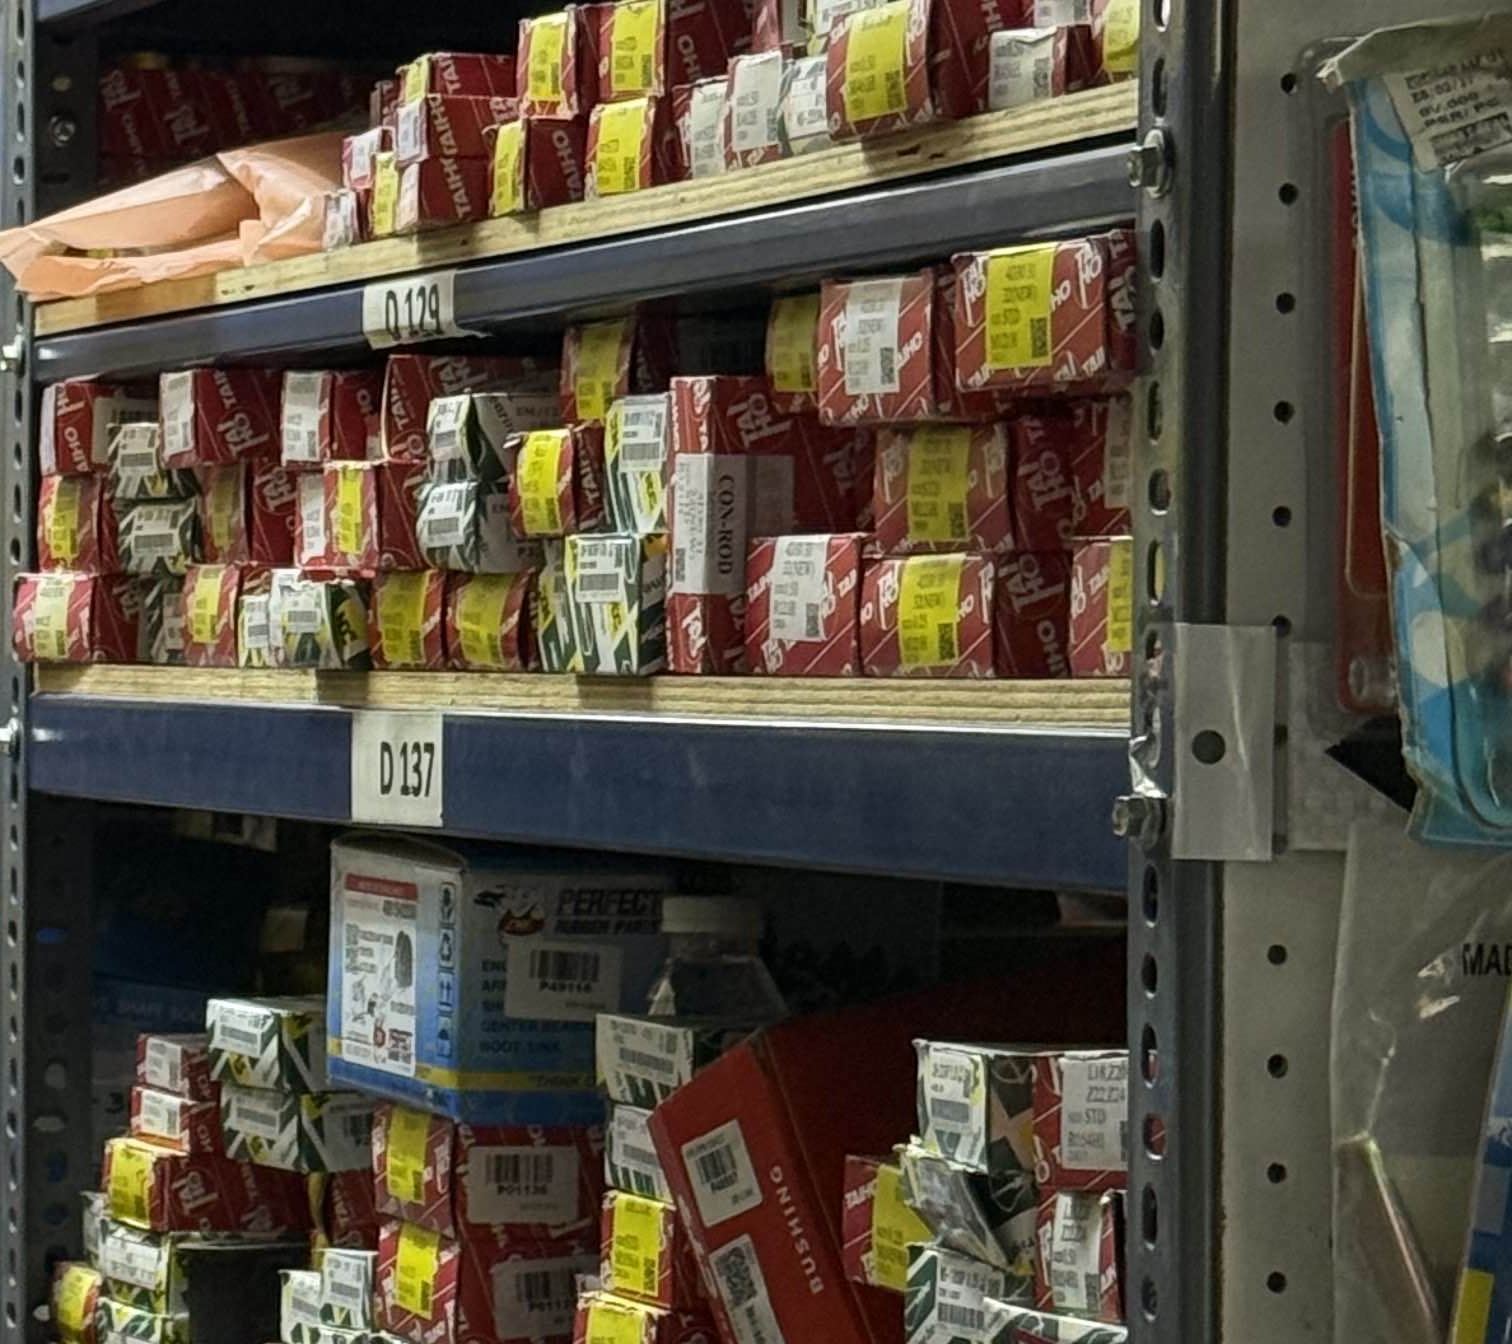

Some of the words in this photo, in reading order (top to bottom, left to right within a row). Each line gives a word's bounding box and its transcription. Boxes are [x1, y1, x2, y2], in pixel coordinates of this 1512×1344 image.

[385, 290, 401, 341] D
[404, 283, 445, 337] 129
[718, 473, 736, 576] CON-ROD
[379, 741, 395, 795] D
[399, 741, 436, 797] 137
[769, 1164, 826, 1296] BUSHING
